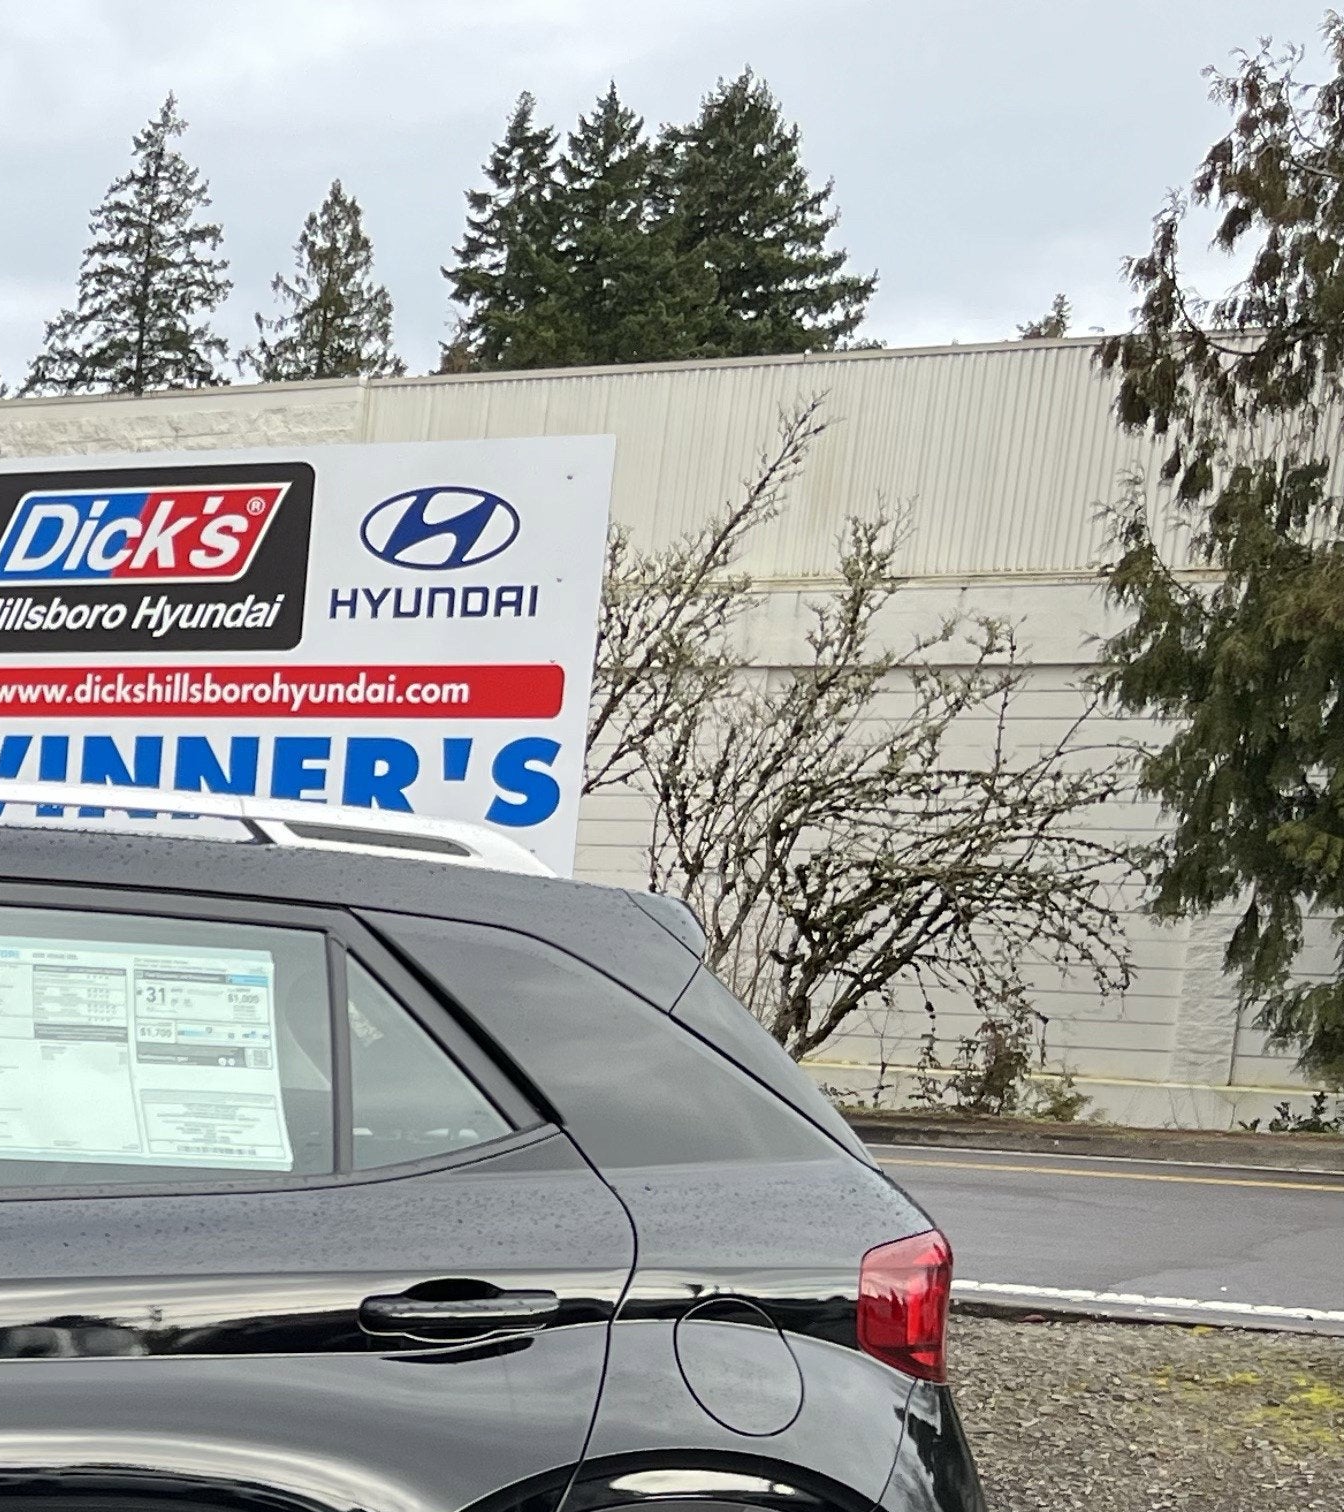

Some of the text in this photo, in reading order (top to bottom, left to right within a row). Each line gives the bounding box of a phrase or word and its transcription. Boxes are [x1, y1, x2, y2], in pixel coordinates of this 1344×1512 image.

[3, 496, 250, 572] Dick's
[130, 593, 286, 638] Hyundai
[328, 585, 538, 620] HYUNDAI
